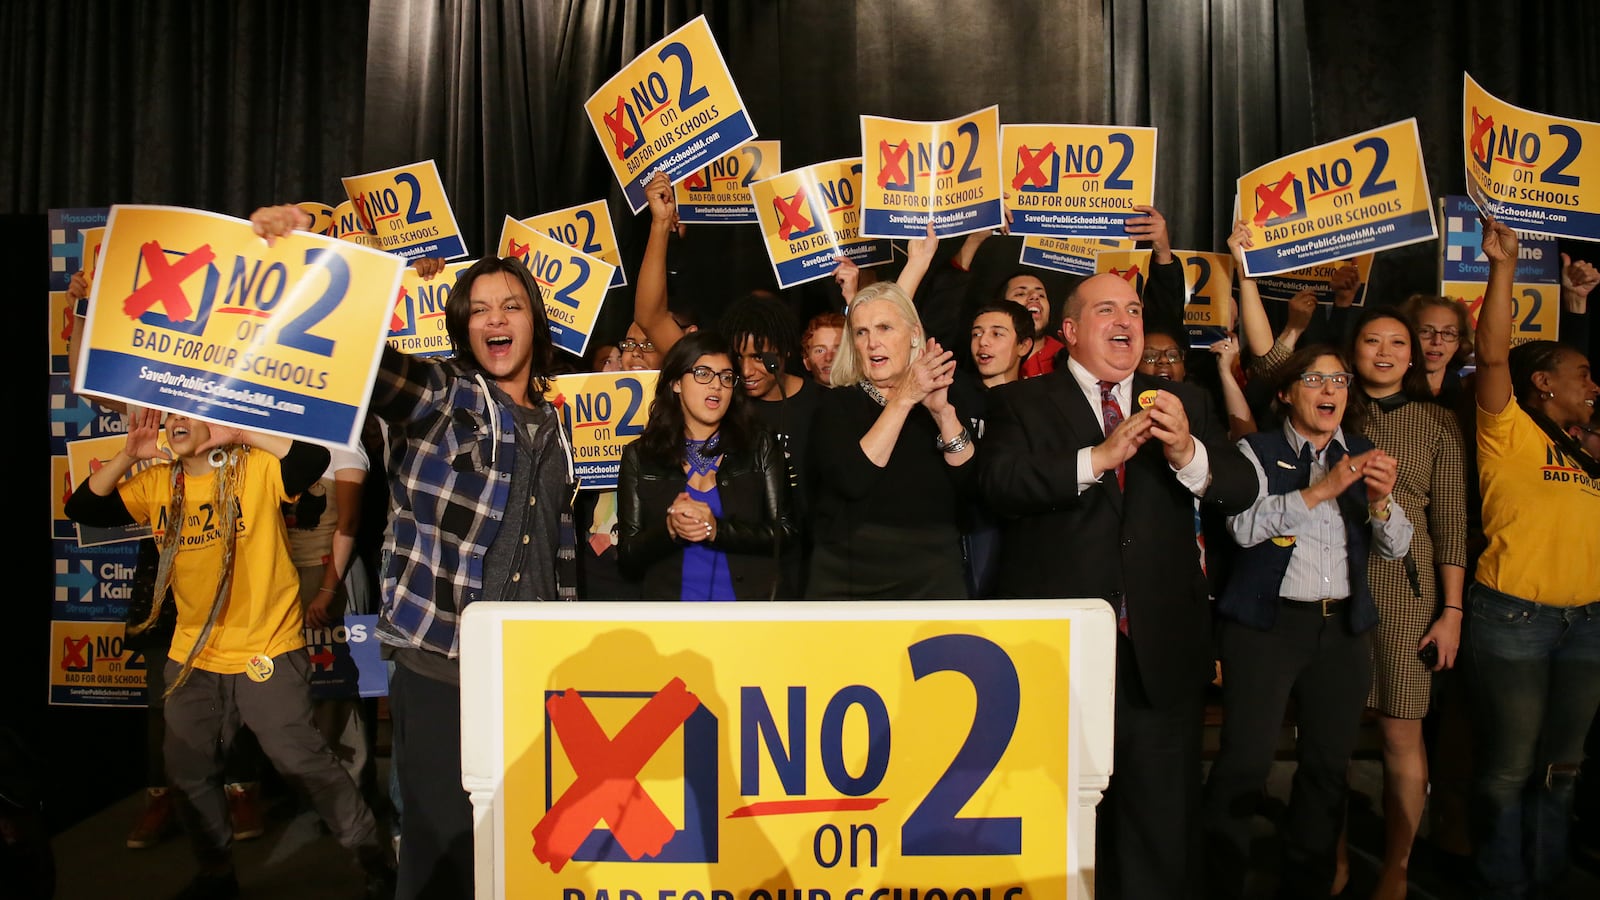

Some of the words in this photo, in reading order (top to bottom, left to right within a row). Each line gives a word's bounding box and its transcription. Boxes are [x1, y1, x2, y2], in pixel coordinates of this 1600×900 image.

[657, 41, 710, 112] 2
[630, 71, 669, 118] NO
[659, 108, 679, 127] on
[626, 156, 641, 175] BAD
[639, 144, 655, 164] FOR
[654, 132, 676, 152] OUR
[674, 104, 719, 140] SCHOOLS
[1498, 124, 1541, 164] NO
[713, 156, 739, 177] NO
[726, 181, 738, 190] on
[741, 146, 763, 187] 2
[917, 141, 955, 172] NO
[937, 176, 953, 190] on
[957, 121, 982, 184] 2
[1065, 144, 1103, 173] NO
[1104, 132, 1135, 190] 2
[1540, 124, 1582, 187] 2
[1082, 180, 1099, 192] on
[1306, 158, 1352, 195] NO
[1333, 192, 1354, 208] on
[1353, 137, 1397, 198] 2
[1513, 168, 1533, 184] on
[368, 188, 399, 216] NO
[394, 172, 432, 225] 2
[689, 193, 702, 202] BAD
[703, 193, 716, 202] FOR
[716, 193, 731, 202] OUR
[733, 193, 752, 202] SCHO
[818, 177, 854, 209] NO
[843, 210, 857, 224] on
[883, 193, 901, 205] BAD
[903, 195, 919, 207] FOR
[945, 186, 984, 206] SCHOOLS
[1018, 195, 1039, 206] BAD
[1042, 195, 1062, 206] FOR
[1065, 196, 1087, 208] OUR
[1089, 197, 1133, 209] SCHOOLS
[1481, 172, 1492, 191] FOR
[1493, 182, 1517, 198] OUR
[1520, 188, 1580, 206] SCHOOLS
[389, 218, 404, 231] on
[548, 223, 578, 245] NO
[575, 210, 602, 254] 2
[1025, 214, 1124, 225] SaveOurPublicSchoolsMA.com
[1264, 228, 1289, 242] BAD
[1291, 220, 1315, 236] FOR
[1317, 213, 1343, 229] OUR
[1345, 199, 1402, 222] SCHOOLS
[383, 234, 400, 246] OUR
[400, 226, 439, 243] SCHOOLS
[789, 240, 810, 254] BAD
[812, 234, 831, 248] FOR
[1039, 238, 1054, 248] BAD
[1055, 241, 1070, 251] FOR
[1070, 244, 1086, 254] OUR
[1277, 223, 1395, 258] SaveOurPublicSchoolsMA.com
[1518, 243, 1543, 260] ine
[530, 250, 562, 284] NO
[553, 256, 591, 310] 2
[1186, 256, 1211, 305] 2
[1314, 266, 1336, 277] SCHO
[1458, 263, 1490, 276] Strong
[1515, 265, 1544, 277] gether
[223, 255, 287, 311] NO
[276, 247, 351, 358] 2
[417, 283, 452, 314] NO
[1519, 288, 1542, 332] 2
[544, 303, 576, 324] HOOLS
[1184, 311, 1211, 321] OOLS
[402, 337, 422, 350] FOR
[424, 335, 443, 348] OUR
[132, 328, 171, 353] BAD
[173, 338, 203, 360] FOR
[203, 344, 238, 368] OUR
[240, 352, 330, 390] SCHOOLS
[138, 365, 306, 415] SaveOurPublicSchoolsMA.com
[575, 392, 612, 422] NO
[594, 427, 610, 440] on
[615, 378, 644, 436] 2
[99, 416, 129, 433] Kai
[580, 446, 600, 458] OUR
[1544, 470, 1570, 482] BAD
[1573, 473, 1590, 488] FOR
[188, 515, 200, 526] on
[199, 503, 214, 532] 2
[206, 521, 246, 542] SCHLS
[100, 562, 136, 580] Clin
[96, 636, 124, 658] NO
[65, 673, 80, 682] BAD
[81, 674, 96, 683] FOR
[97, 674, 112, 684] OUR
[108, 662, 121, 672] on
[740, 684, 891, 797] NO
[901, 633, 1023, 857] 2
[813, 822, 878, 869] on
